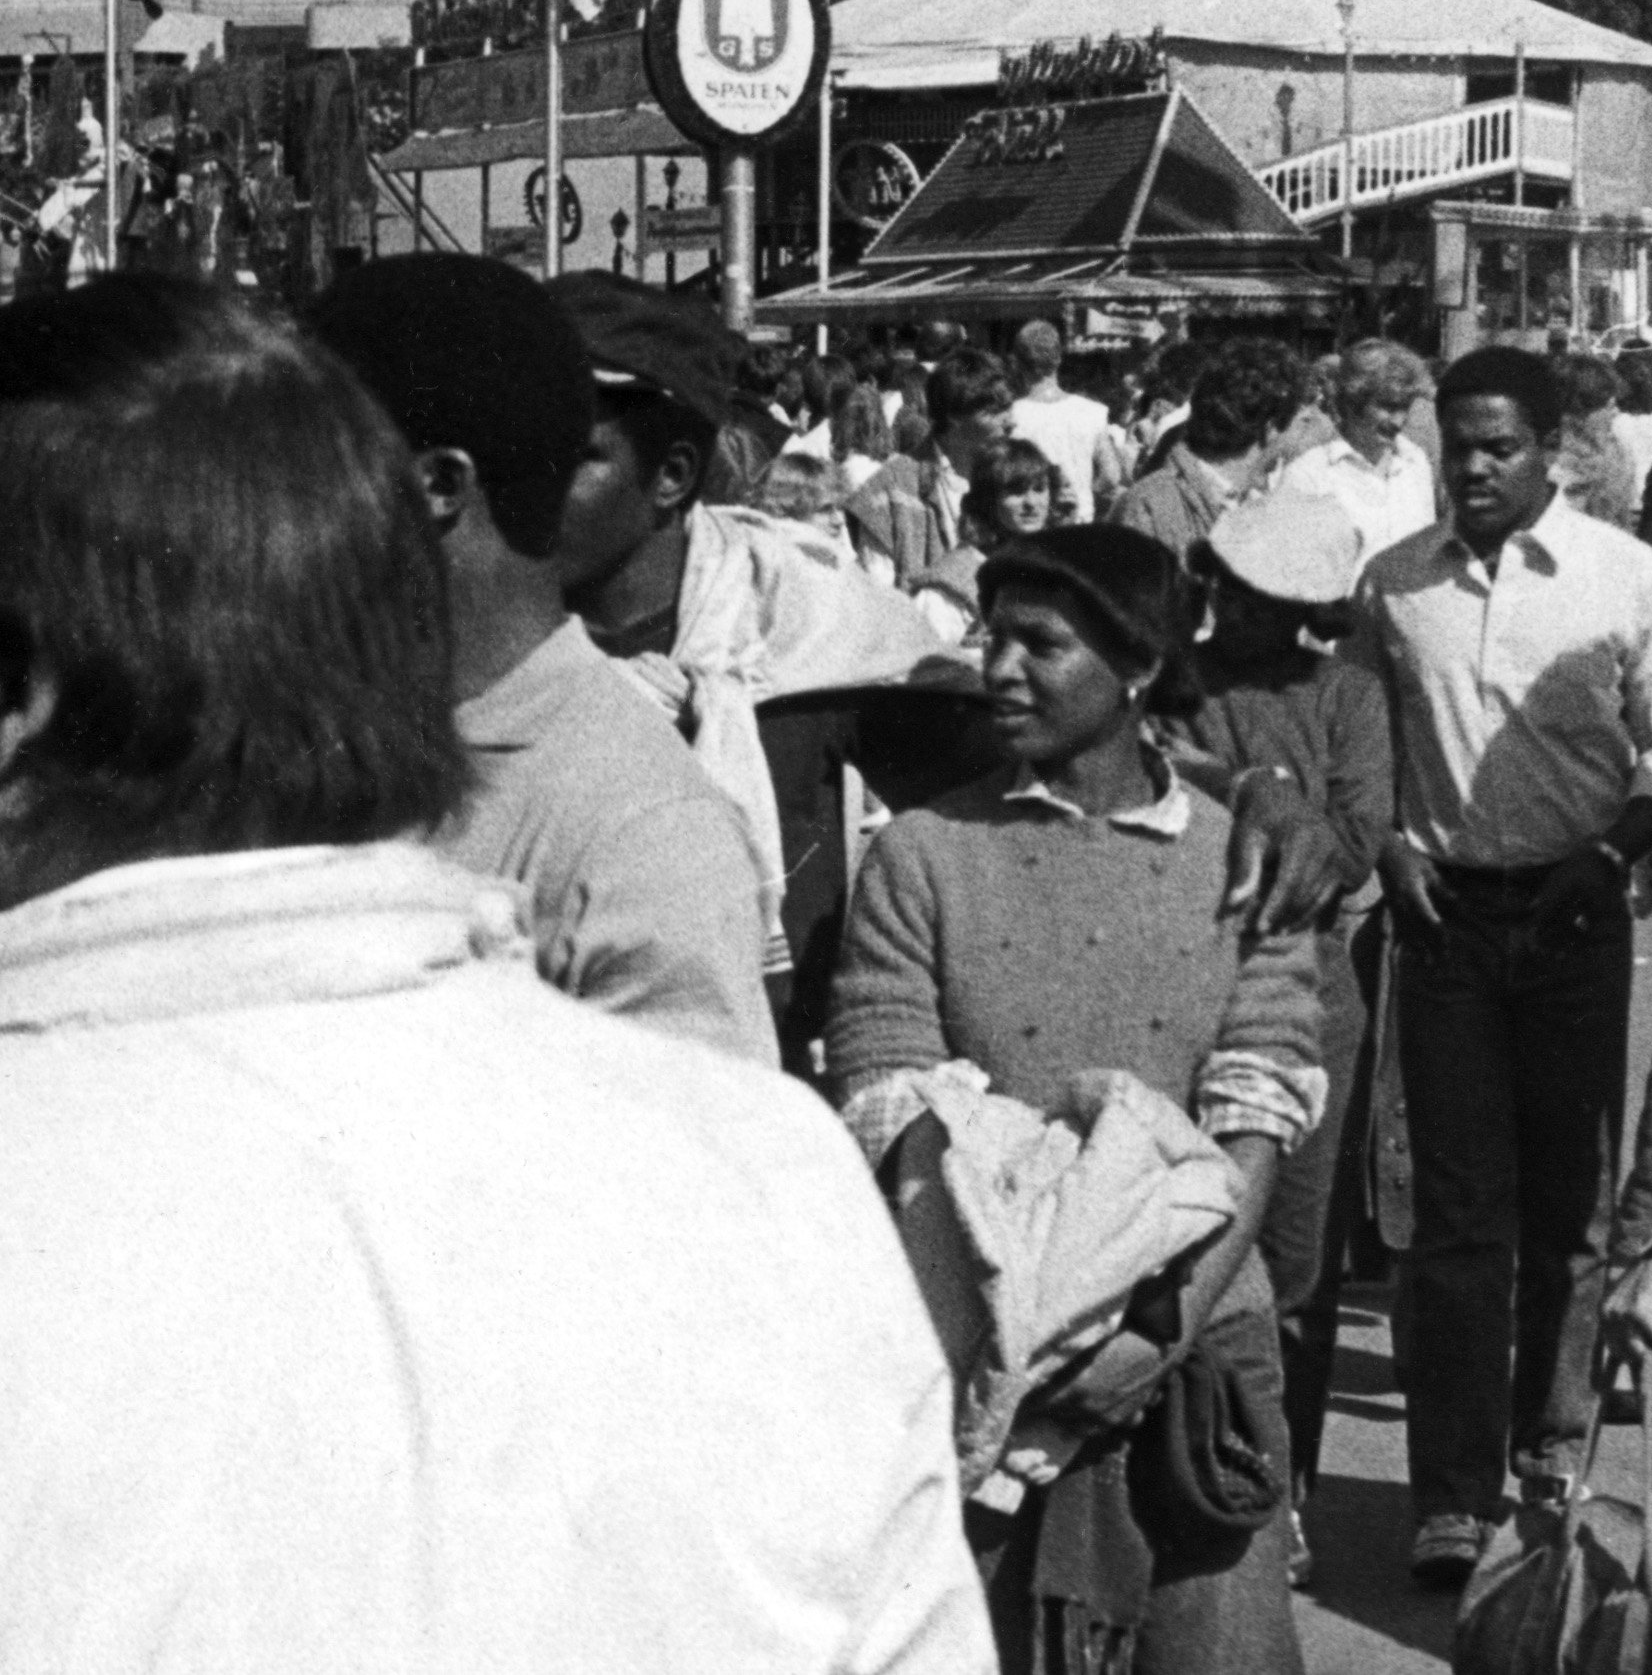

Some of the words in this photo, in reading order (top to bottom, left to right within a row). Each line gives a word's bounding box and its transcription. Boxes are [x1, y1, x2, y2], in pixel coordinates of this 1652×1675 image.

[718, 39, 736, 57] G
[758, 40, 775, 58] S
[705, 80, 790, 100] SPATEN
